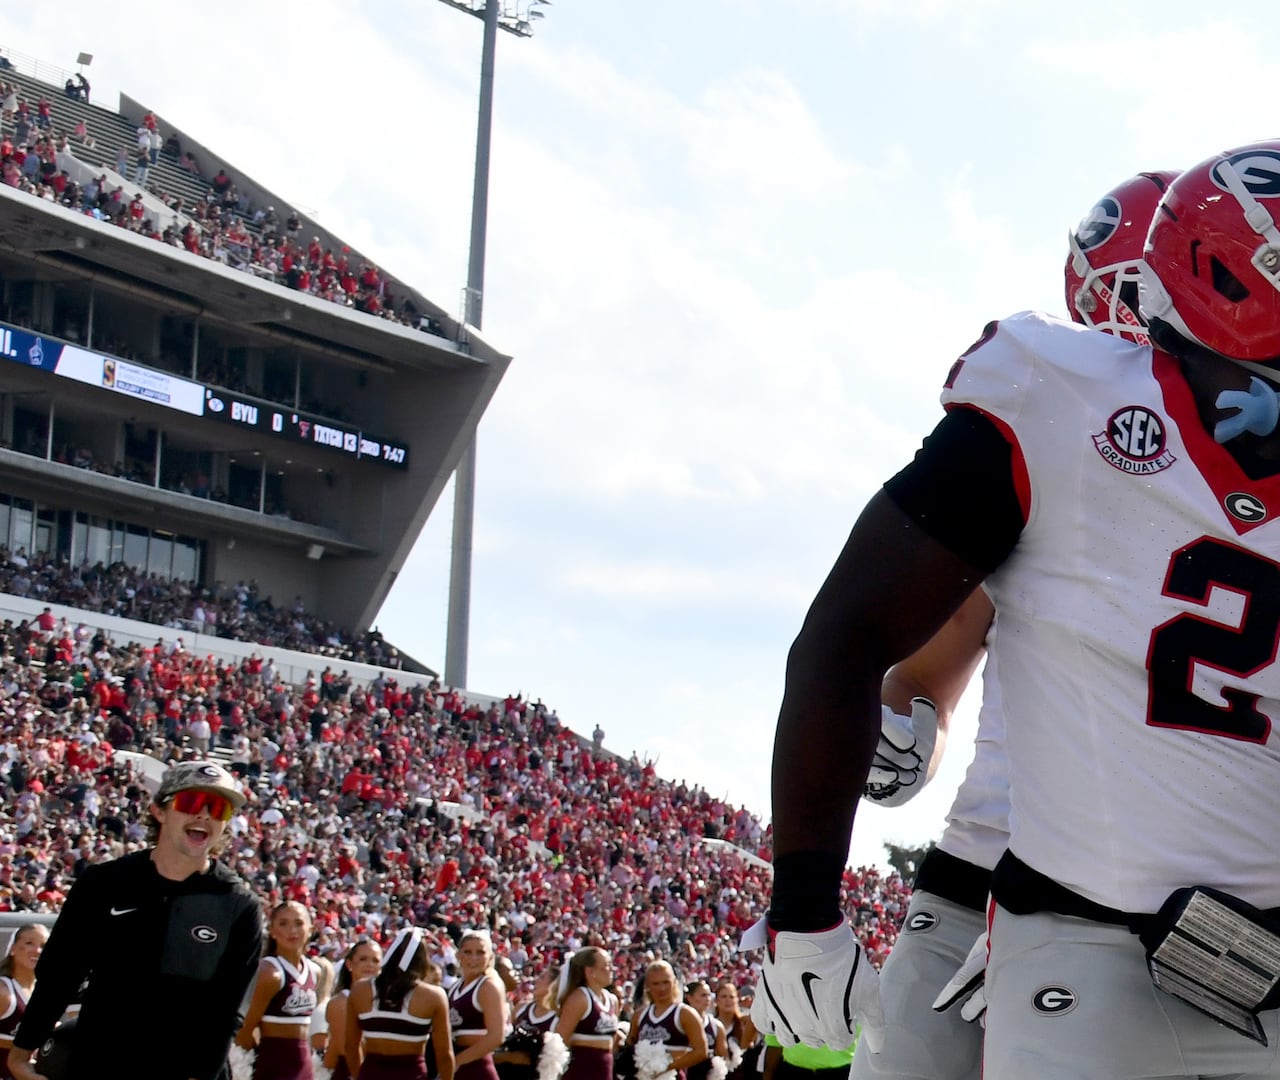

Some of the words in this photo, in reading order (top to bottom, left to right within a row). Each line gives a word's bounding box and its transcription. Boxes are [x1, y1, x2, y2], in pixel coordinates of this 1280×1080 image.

[1099, 287, 1151, 346] BULDGS
[231, 401, 257, 425] BYU
[271, 412, 284, 432] 0
[344, 432, 358, 453] 13
[1112, 409, 1162, 457] SEC
[1101, 445, 1165, 474] GRADUATE
[1229, 496, 1267, 519] G
[907, 911, 938, 931] G
[1036, 987, 1077, 1012] G
